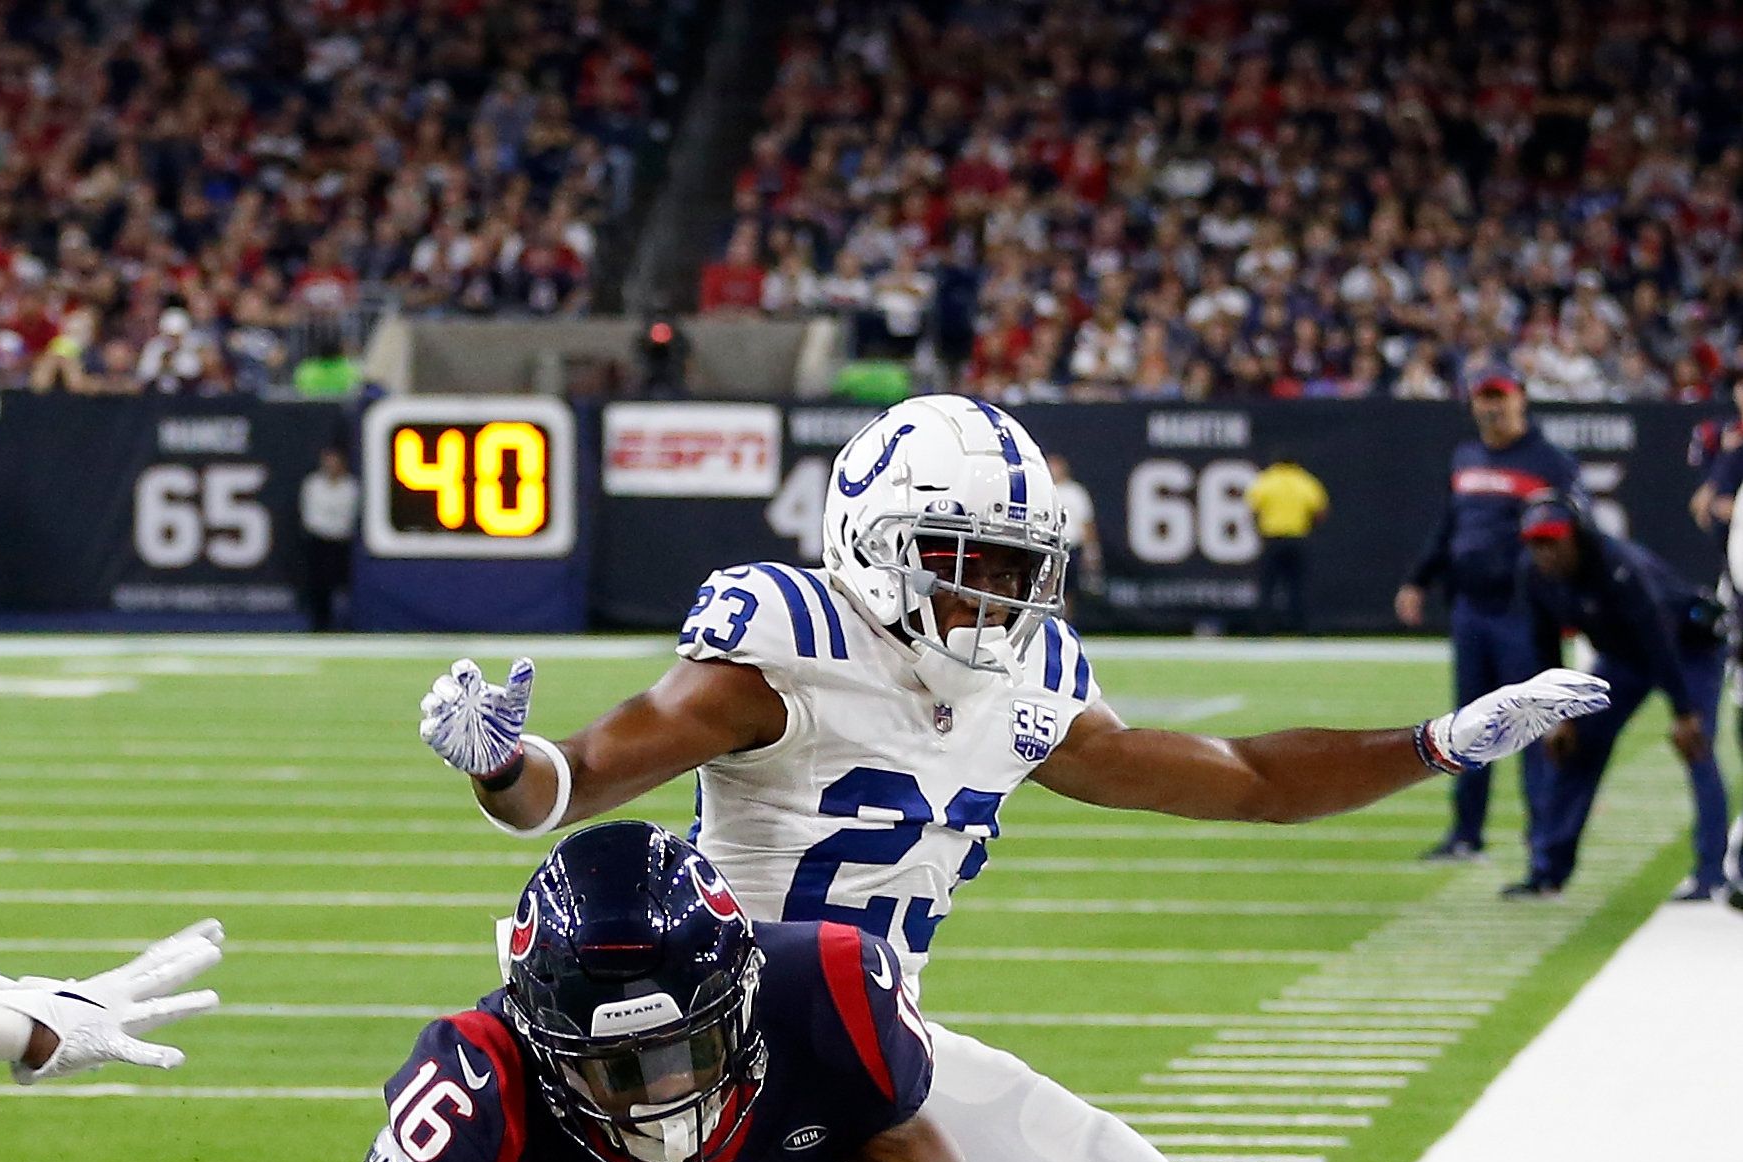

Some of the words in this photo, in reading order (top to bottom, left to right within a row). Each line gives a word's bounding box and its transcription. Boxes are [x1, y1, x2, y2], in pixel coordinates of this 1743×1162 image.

[393, 420, 547, 537] 40
[609, 430, 767, 471] ESPN
[133, 463, 272, 568] 65
[1127, 458, 1263, 564] 66
[679, 586, 759, 652] 23
[1013, 700, 1057, 745] 35
[603, 1003, 663, 1019] TEXANS
[389, 1057, 475, 1162] 16
